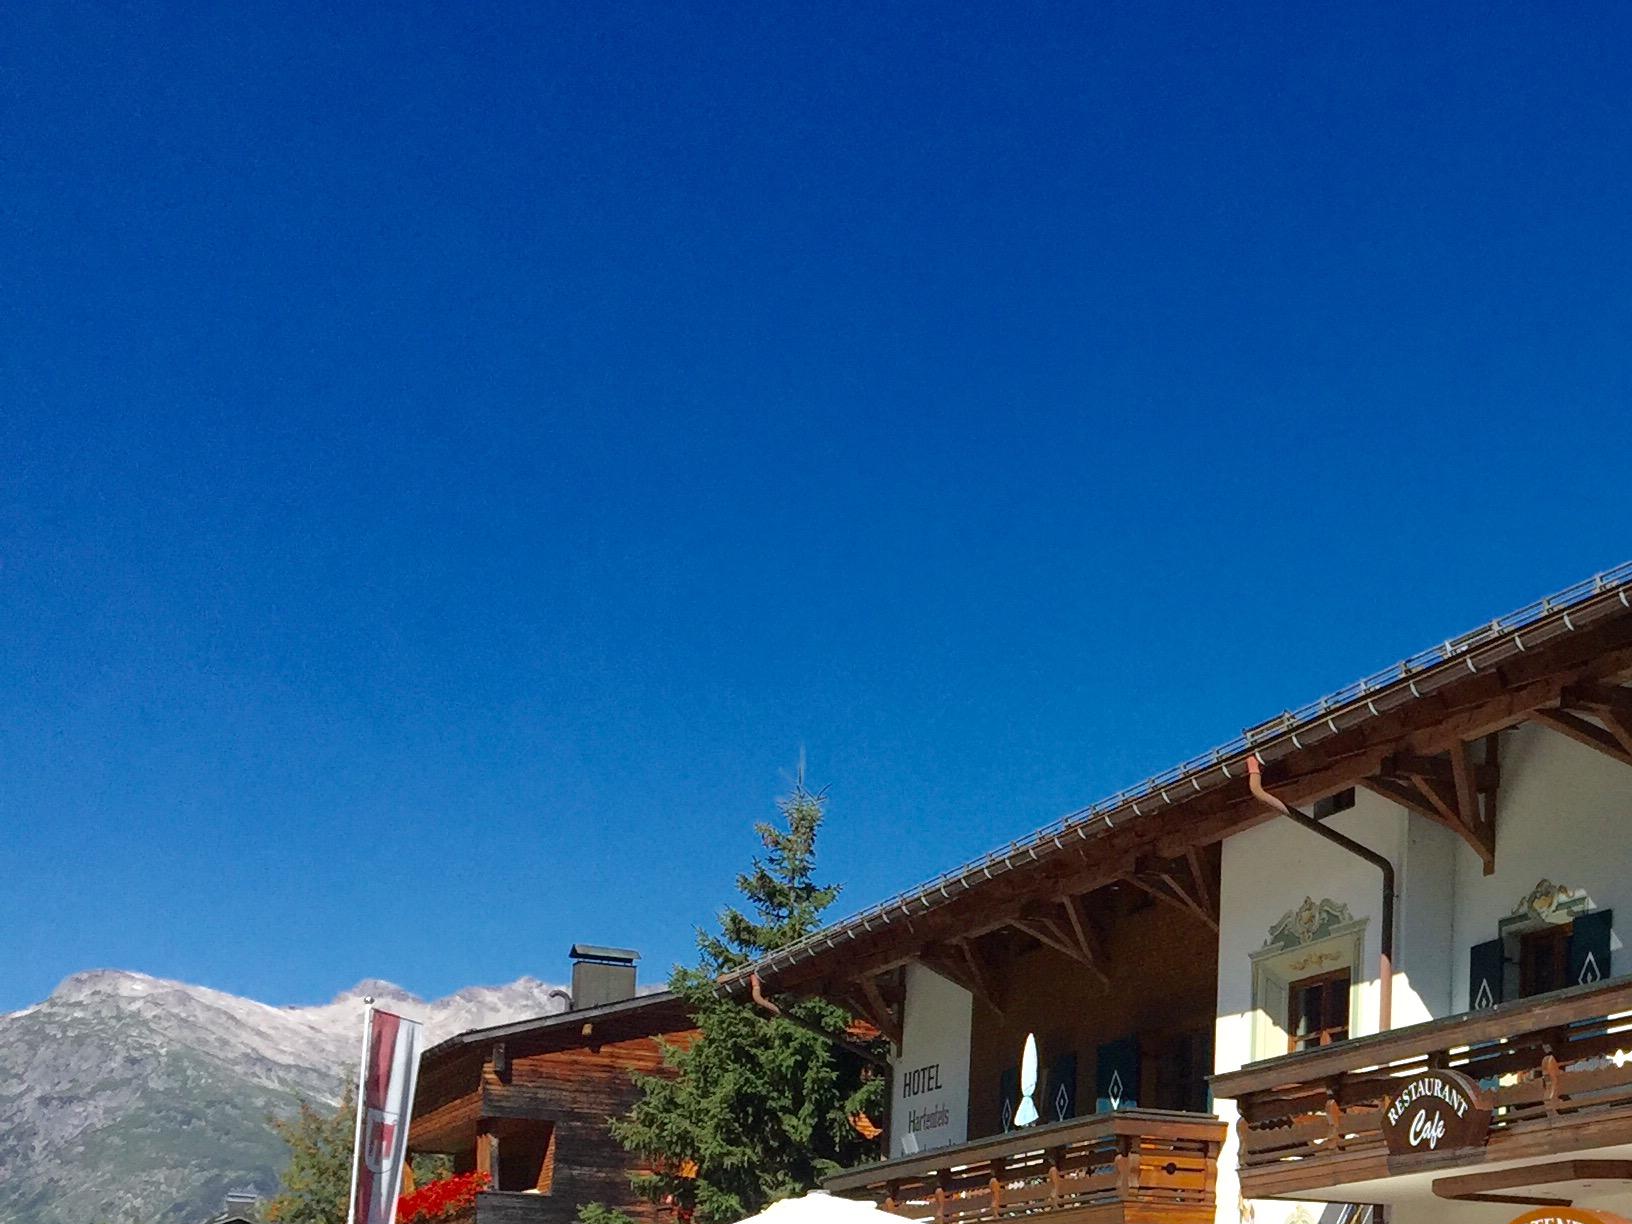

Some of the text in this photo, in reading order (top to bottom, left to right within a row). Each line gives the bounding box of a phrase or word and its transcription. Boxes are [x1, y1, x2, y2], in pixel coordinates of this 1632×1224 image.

[903, 1063, 942, 1098] HOTEL
[1387, 1078, 1469, 1127] RESTAURANT
[1409, 1109, 1446, 1150] Cafe
